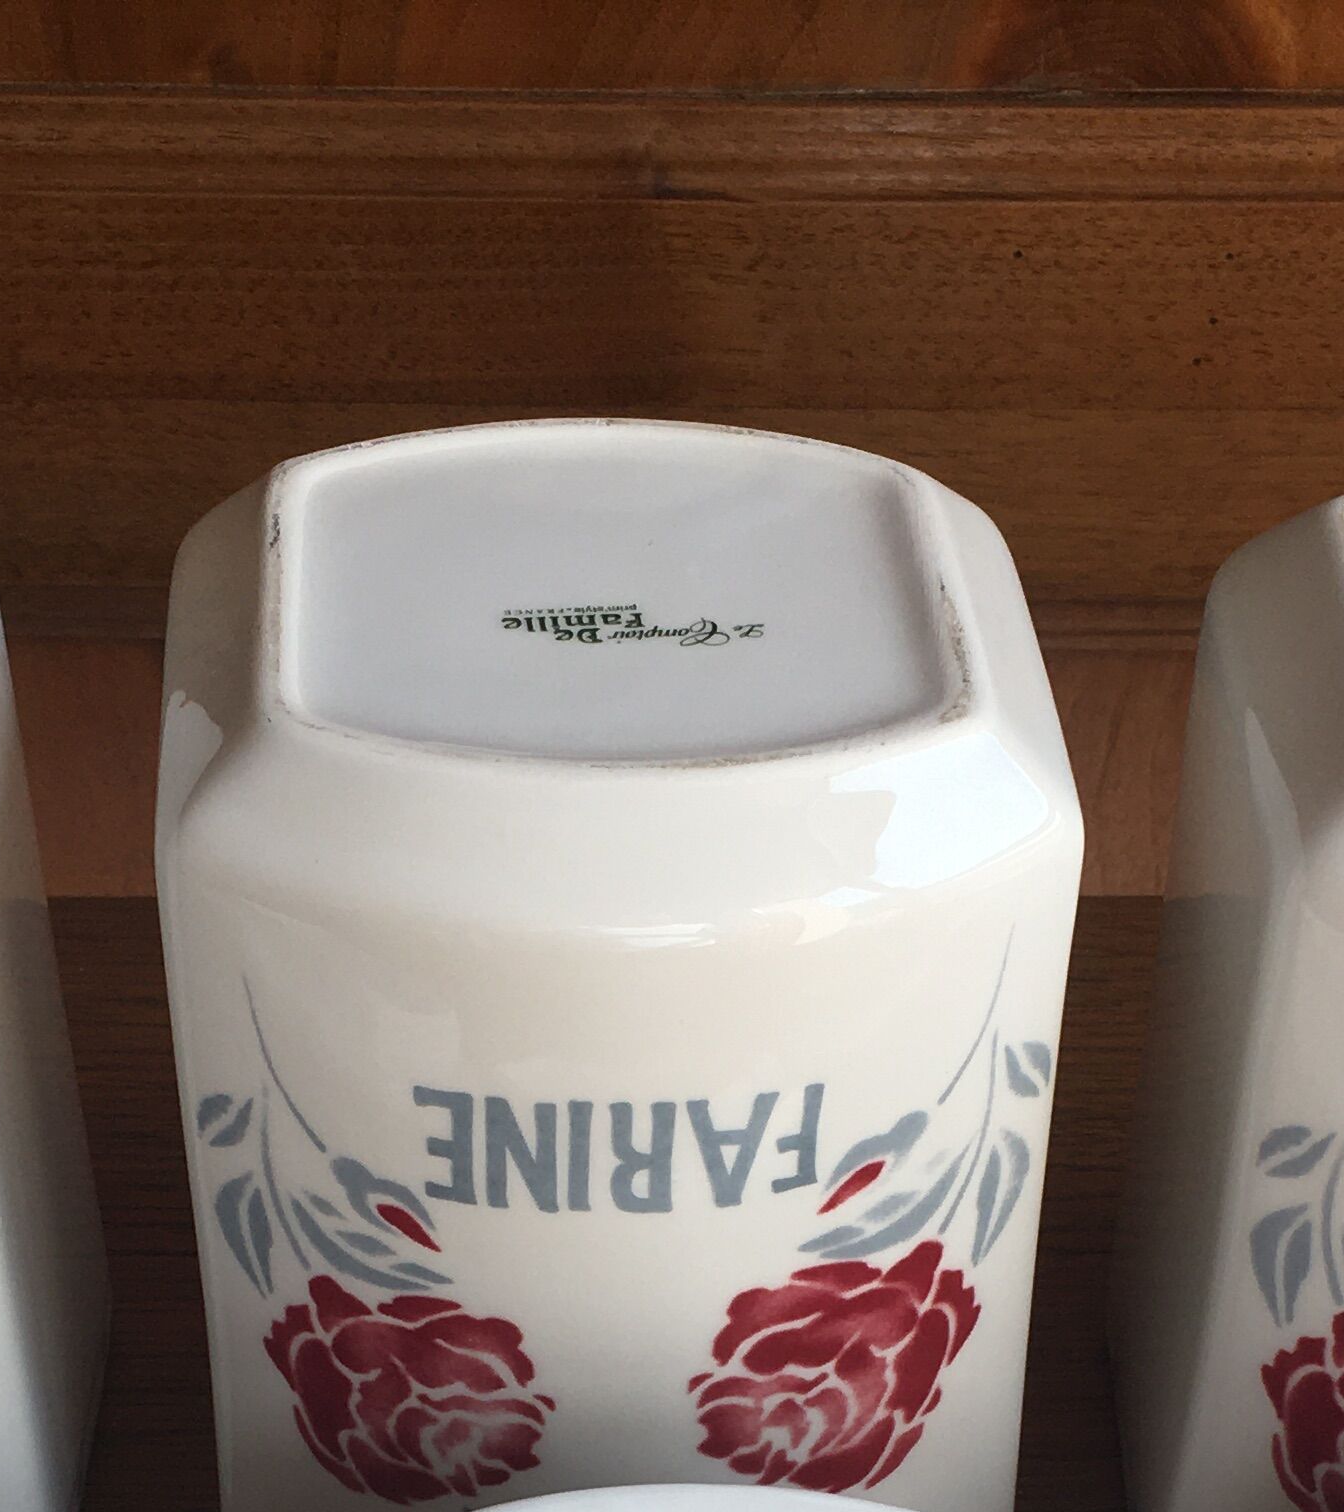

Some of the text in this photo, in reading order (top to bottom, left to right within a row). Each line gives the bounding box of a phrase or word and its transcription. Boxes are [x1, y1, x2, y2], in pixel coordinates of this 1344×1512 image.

[501, 612, 644, 632] Famille
[555, 618, 764, 647] Le Comptoir De
[413, 1083, 825, 1213] FARINE
